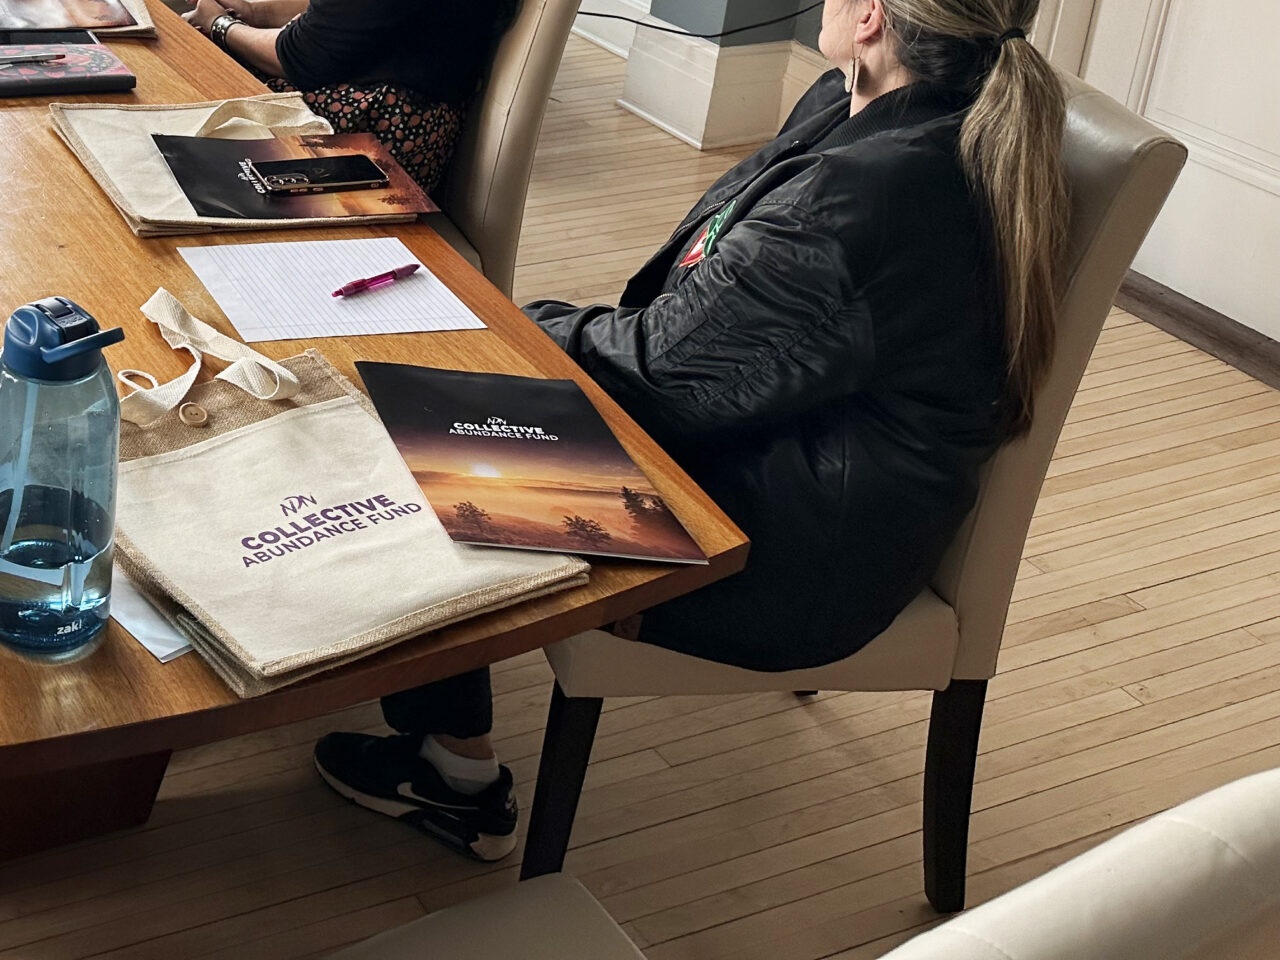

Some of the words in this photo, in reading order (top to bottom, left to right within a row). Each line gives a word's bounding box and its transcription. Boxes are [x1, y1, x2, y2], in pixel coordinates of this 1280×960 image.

[448, 428, 523, 439] ABUNDANCE
[526, 433, 559, 441] FUND
[453, 422, 545, 435] COLLECTIVE
[241, 494, 396, 550] COLLECTIVE
[242, 518, 368, 568] ABUNDANCE
[366, 503, 422, 526] FUND
